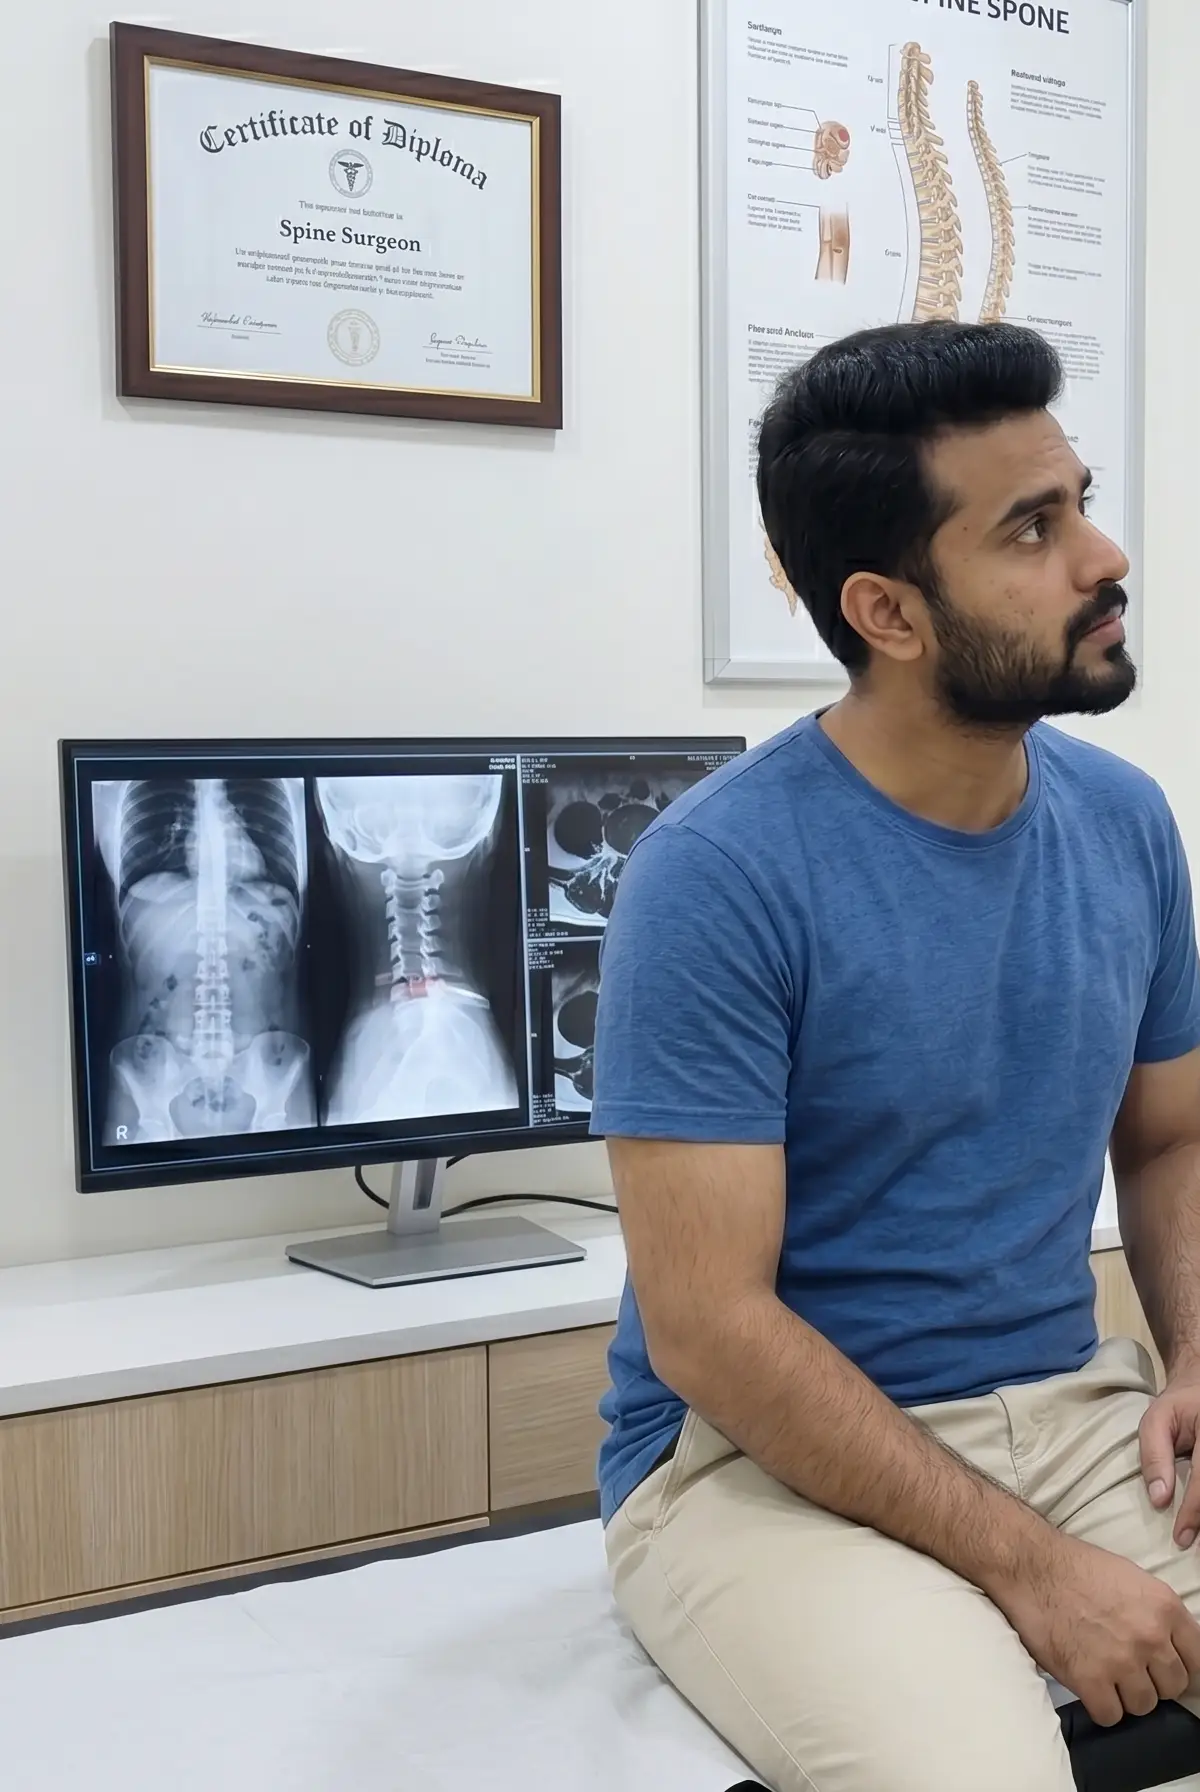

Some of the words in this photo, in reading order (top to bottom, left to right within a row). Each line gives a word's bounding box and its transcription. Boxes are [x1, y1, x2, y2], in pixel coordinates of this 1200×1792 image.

[987, 0, 1070, 34] SPONE
[199, 108, 339, 153] Certificate
[348, 115, 372, 142] of
[381, 117, 488, 190] Diploma
[279, 219, 336, 244] Spine
[341, 227, 422, 254] Surgeon
[116, 1125, 128, 1140] R
